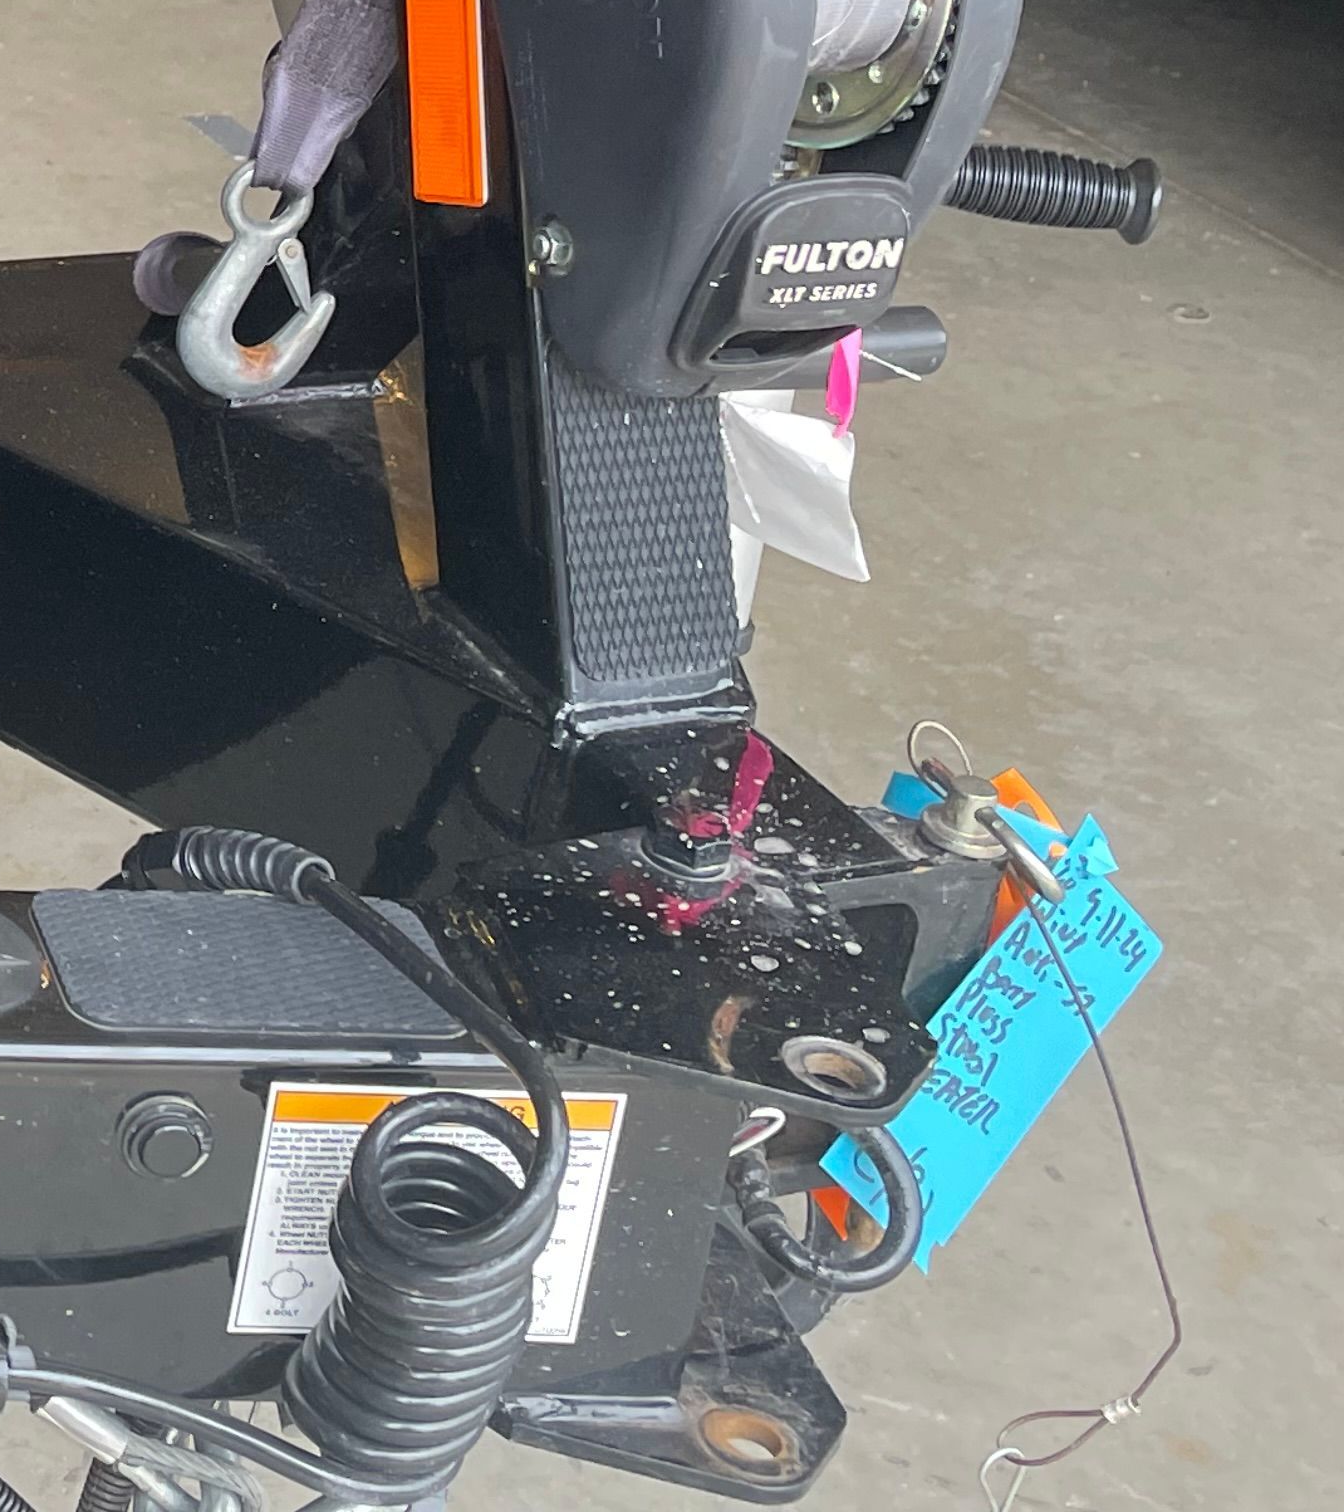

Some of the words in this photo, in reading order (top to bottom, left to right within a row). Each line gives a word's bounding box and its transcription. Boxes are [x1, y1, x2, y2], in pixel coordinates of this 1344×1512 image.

[761, 237, 905, 275] FULTON
[769, 286, 807, 304] XLT
[808, 282, 879, 302] SERIES
